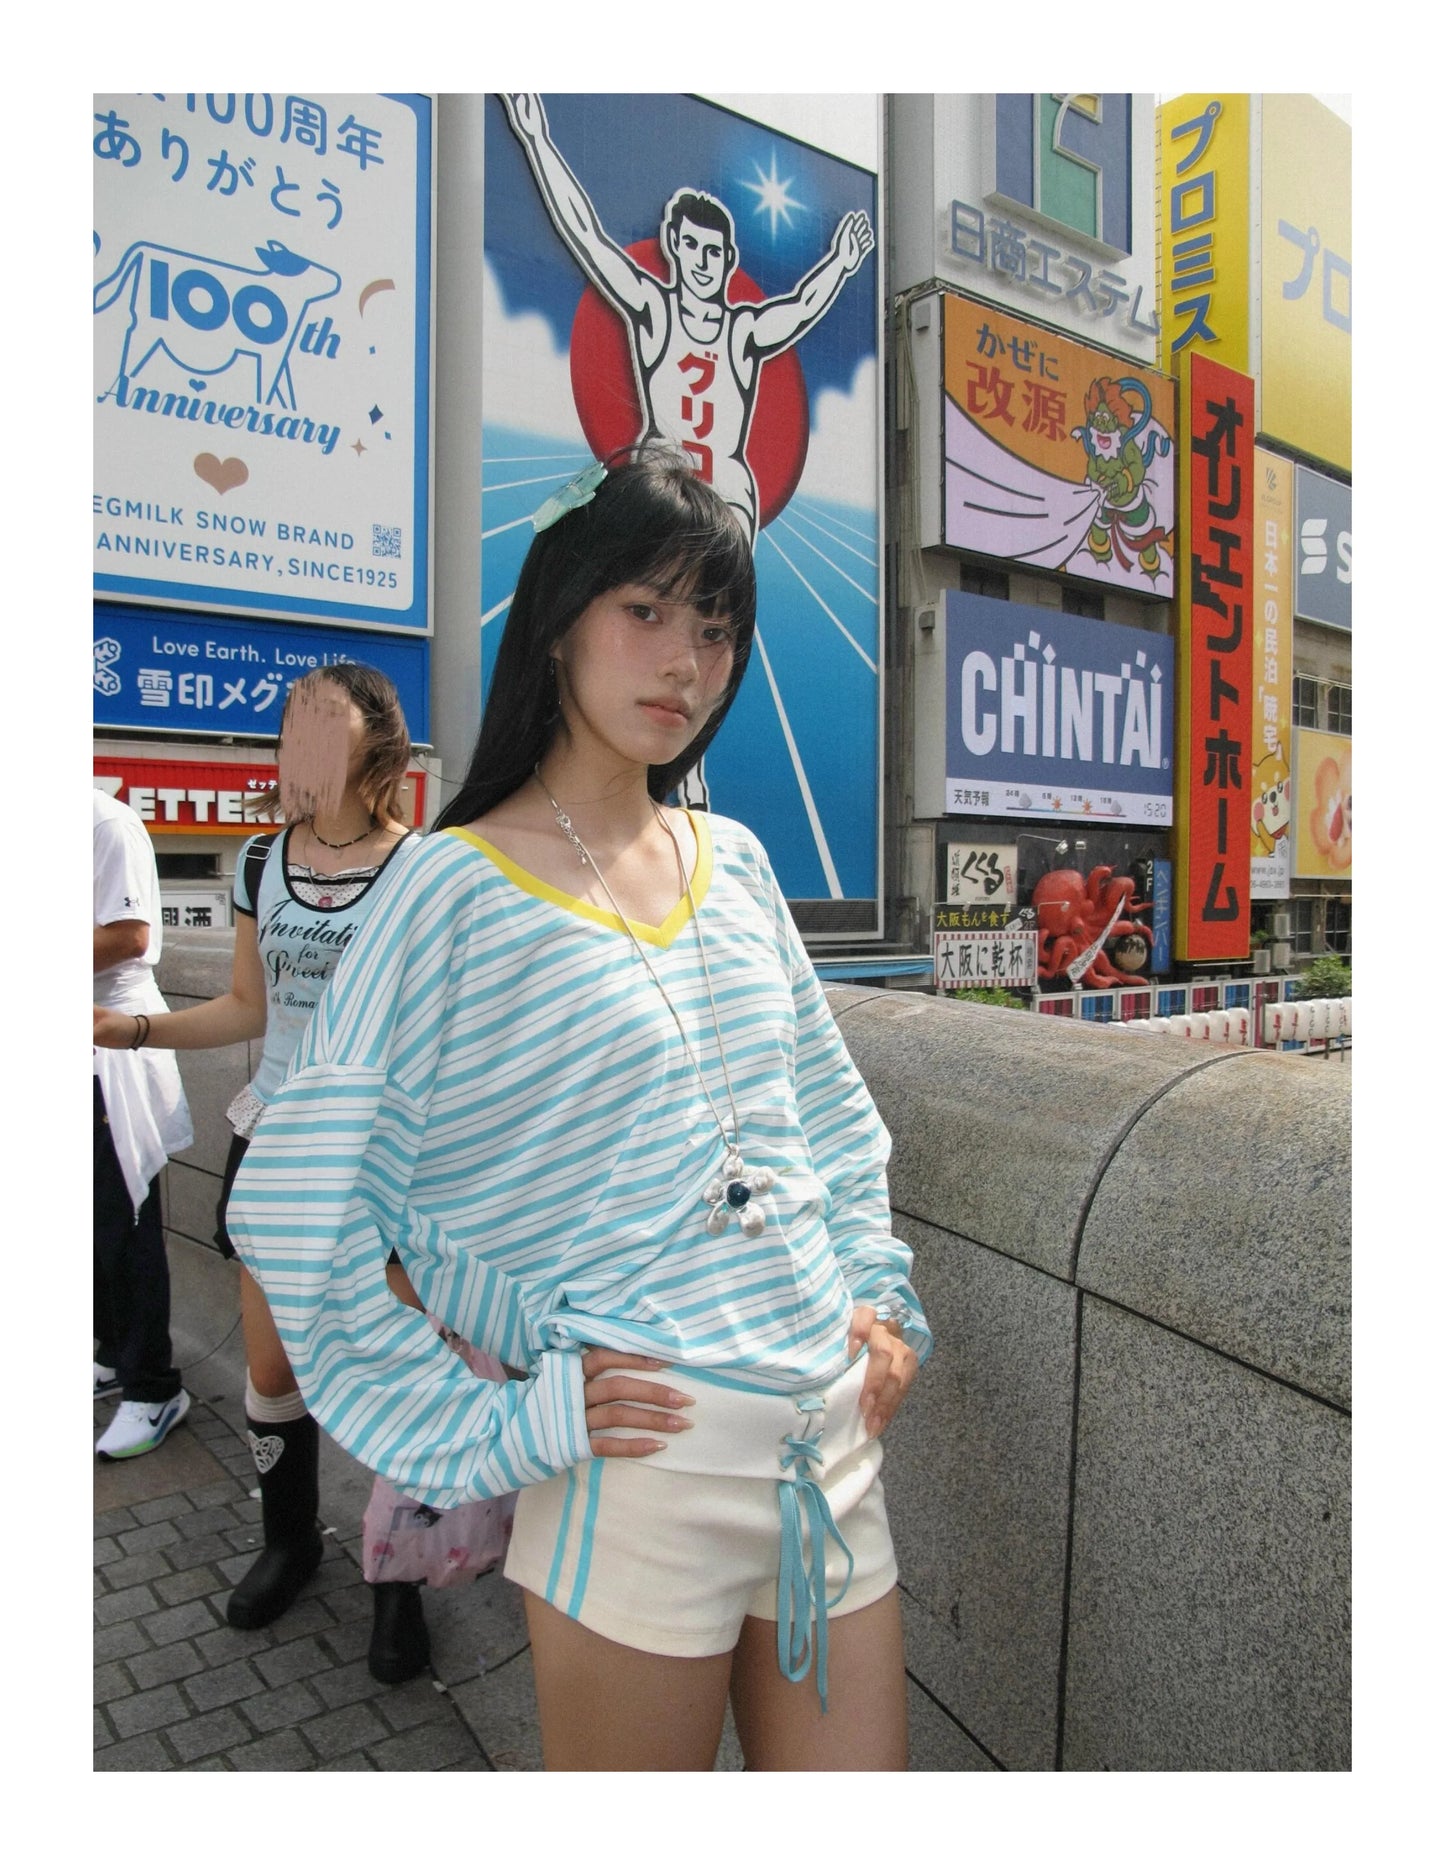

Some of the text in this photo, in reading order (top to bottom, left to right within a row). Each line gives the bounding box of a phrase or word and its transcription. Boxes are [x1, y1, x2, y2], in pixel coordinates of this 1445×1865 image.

[93, 110, 343, 230] ありがとう
[1171, 101, 1221, 354] プロミス
[948, 199, 1160, 336] 日商エステム
[976, 323, 1060, 382] かぜに
[97, 373, 341, 455] Anniversary
[677, 351, 719, 485] グリコ
[965, 359, 1068, 443] 改源
[196, 510, 266, 537] SNOW
[277, 523, 354, 550] BRAND
[152, 635, 199, 657] Love
[205, 641, 266, 663] Earth.
[275, 647, 318, 668] Love
[1191, 397, 1246, 922] オリエントホーム
[137, 668, 294, 713] 雪印メグ
[961, 627, 1164, 769] CHINTAI
[953, 789, 990, 807] 天気予報
[960, 850, 1004, 896] くくる
[297, 943, 320, 963] for
[940, 941, 1024, 979] 大阪に乾杯
[283, 992, 318, 1009] Roma
